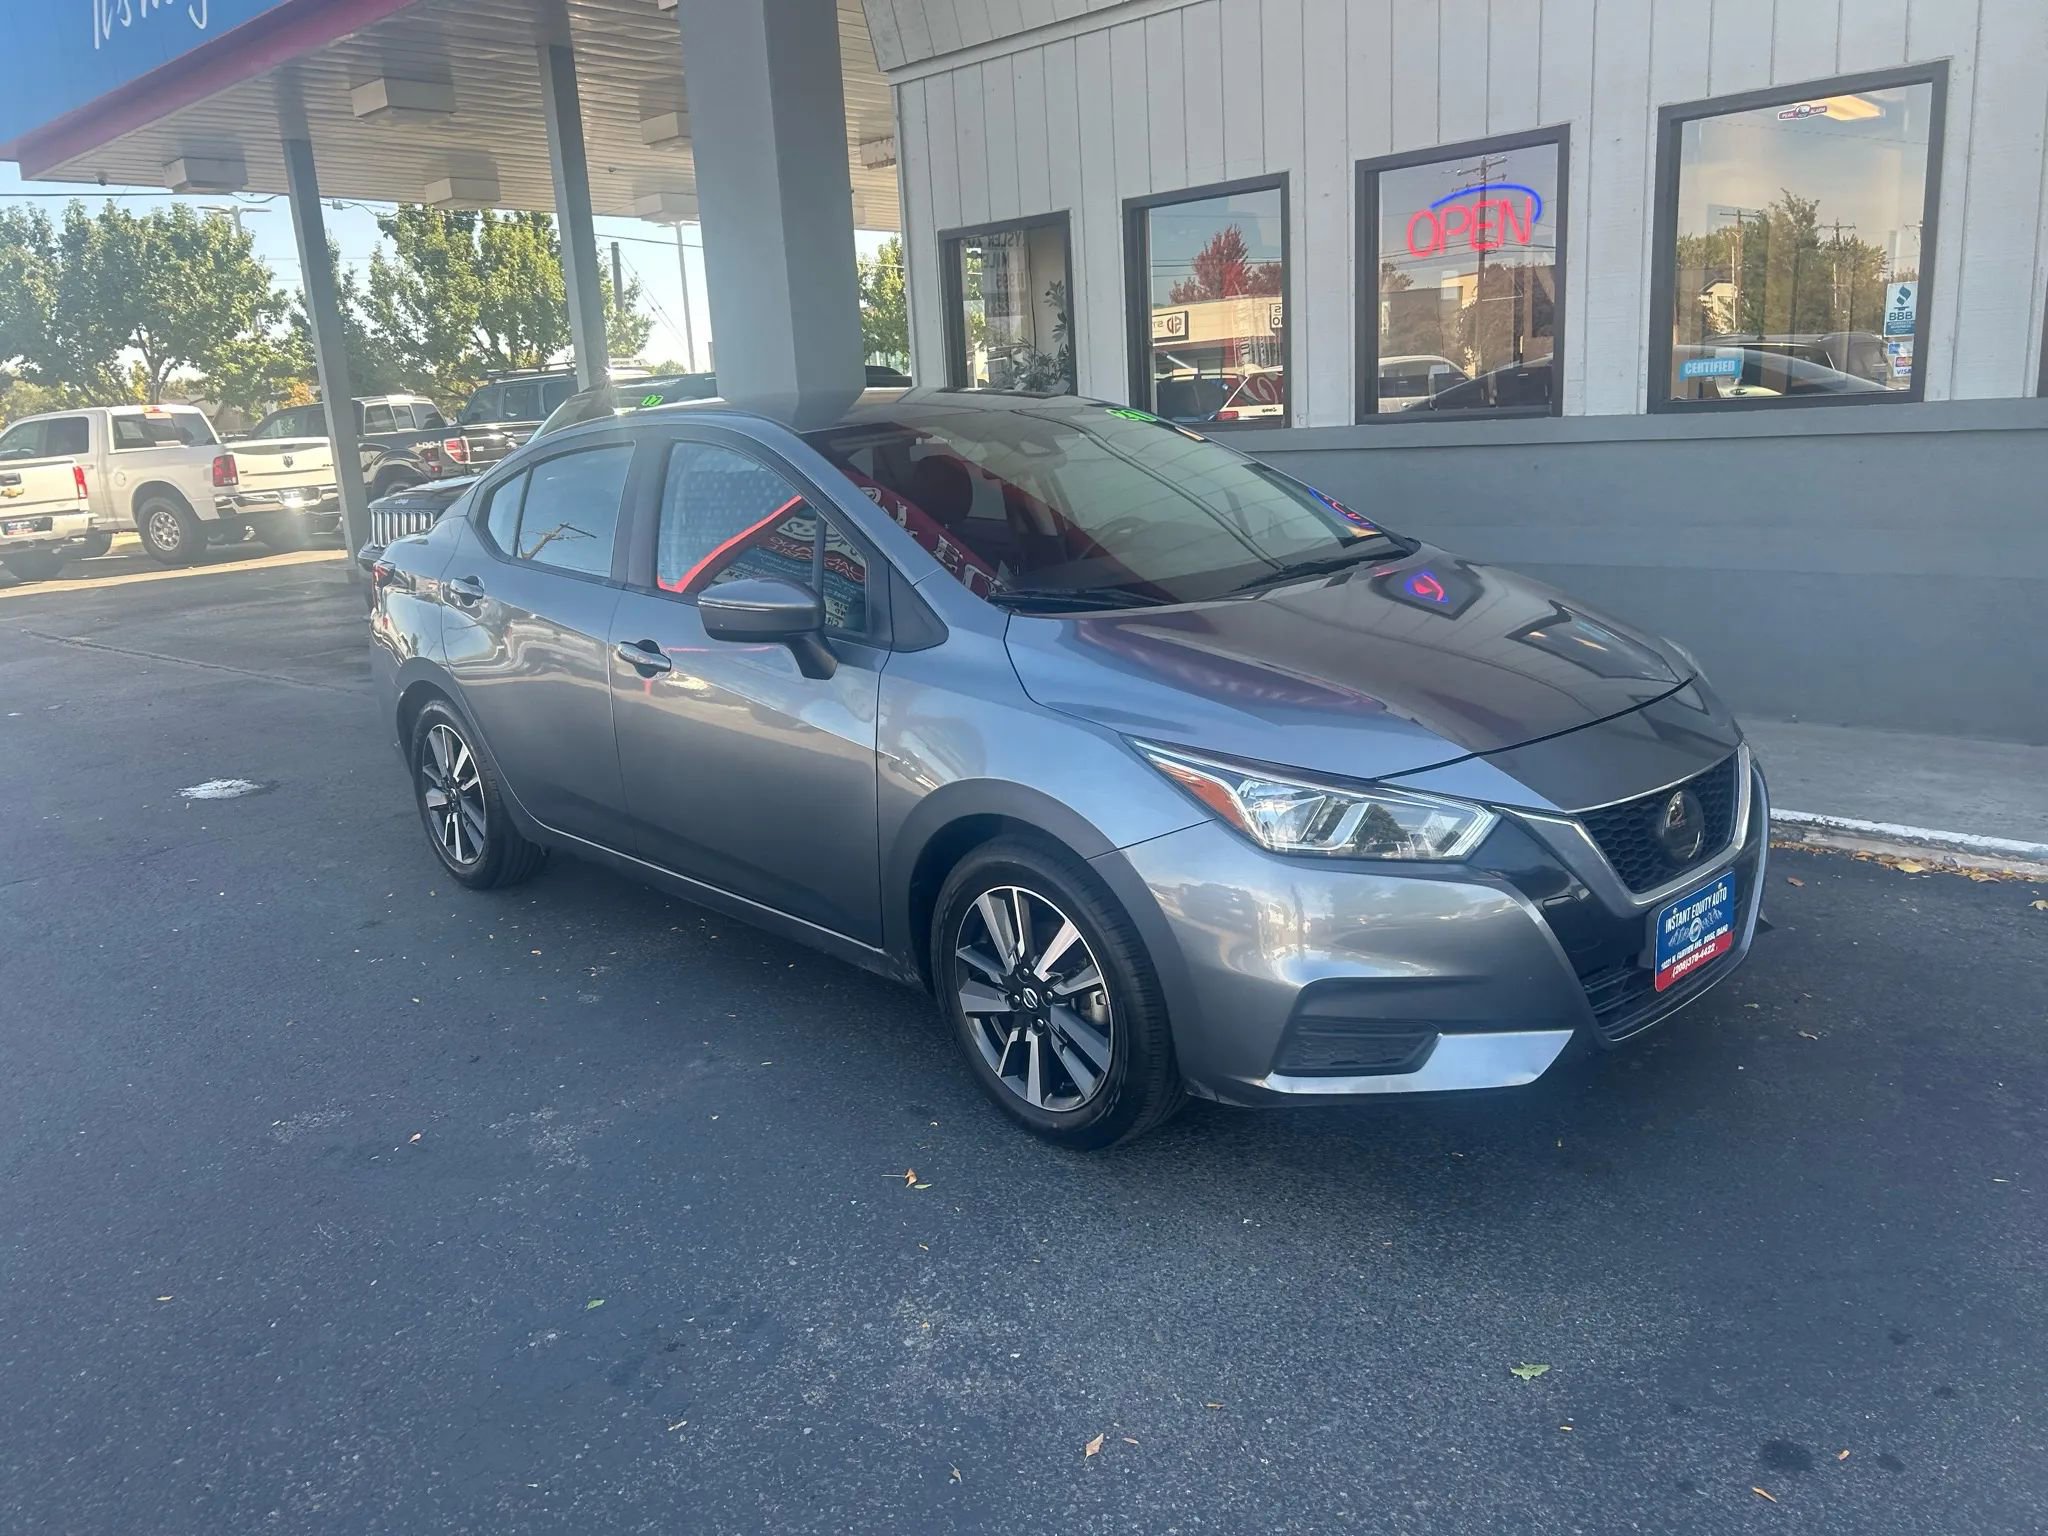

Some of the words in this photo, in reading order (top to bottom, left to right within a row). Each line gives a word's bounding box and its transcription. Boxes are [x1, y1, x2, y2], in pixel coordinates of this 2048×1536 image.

[1406, 196, 1533, 257] OPEN
[1889, 311, 1913, 321] BBB
[1685, 360, 1735, 374] CERTIFIED
[1665, 906, 1692, 934] INSTANT
[1691, 894, 1713, 918] EQUITY
[1712, 886, 1728, 907] AUTO
